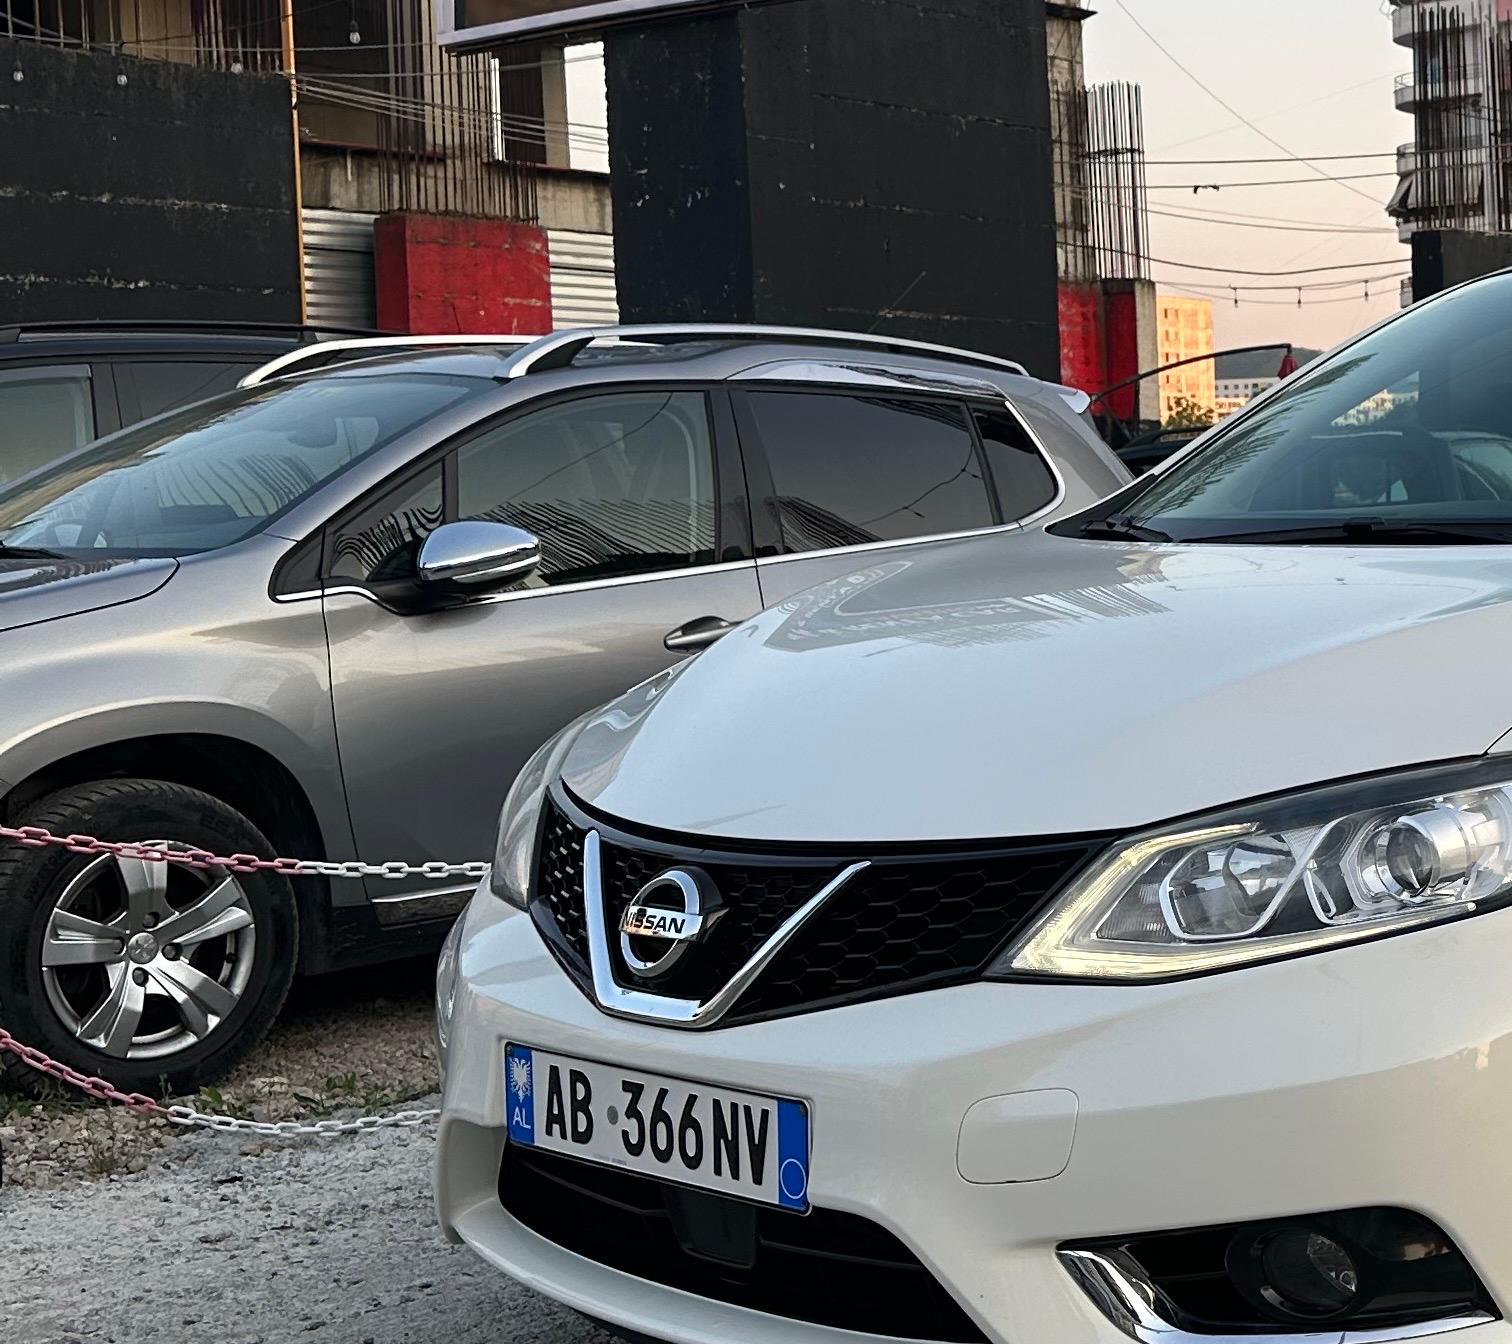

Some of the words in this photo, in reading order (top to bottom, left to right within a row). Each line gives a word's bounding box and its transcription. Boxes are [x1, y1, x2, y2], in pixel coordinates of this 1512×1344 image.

[622, 905, 686, 935] NISSAN
[545, 1064, 594, 1145] AB
[513, 1110, 532, 1130] AL
